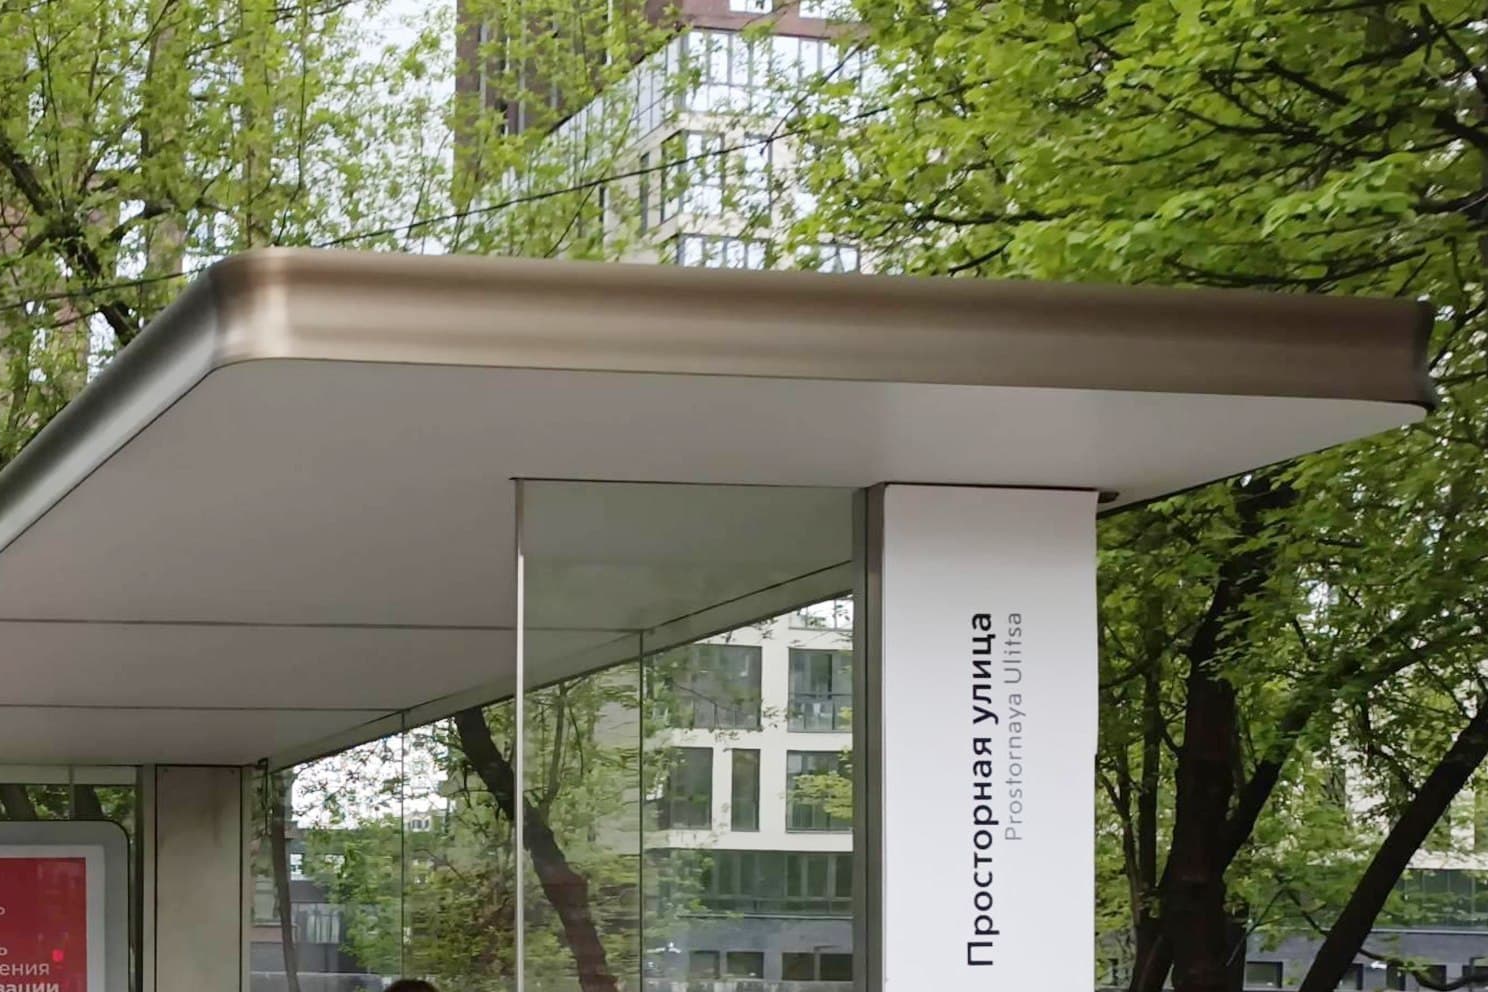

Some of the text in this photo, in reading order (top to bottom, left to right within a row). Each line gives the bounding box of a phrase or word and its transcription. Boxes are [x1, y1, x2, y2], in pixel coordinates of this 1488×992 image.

[967, 613, 1000, 966] Просторная улица
[1002, 613, 1026, 841] Prostornaya Ulitsa
